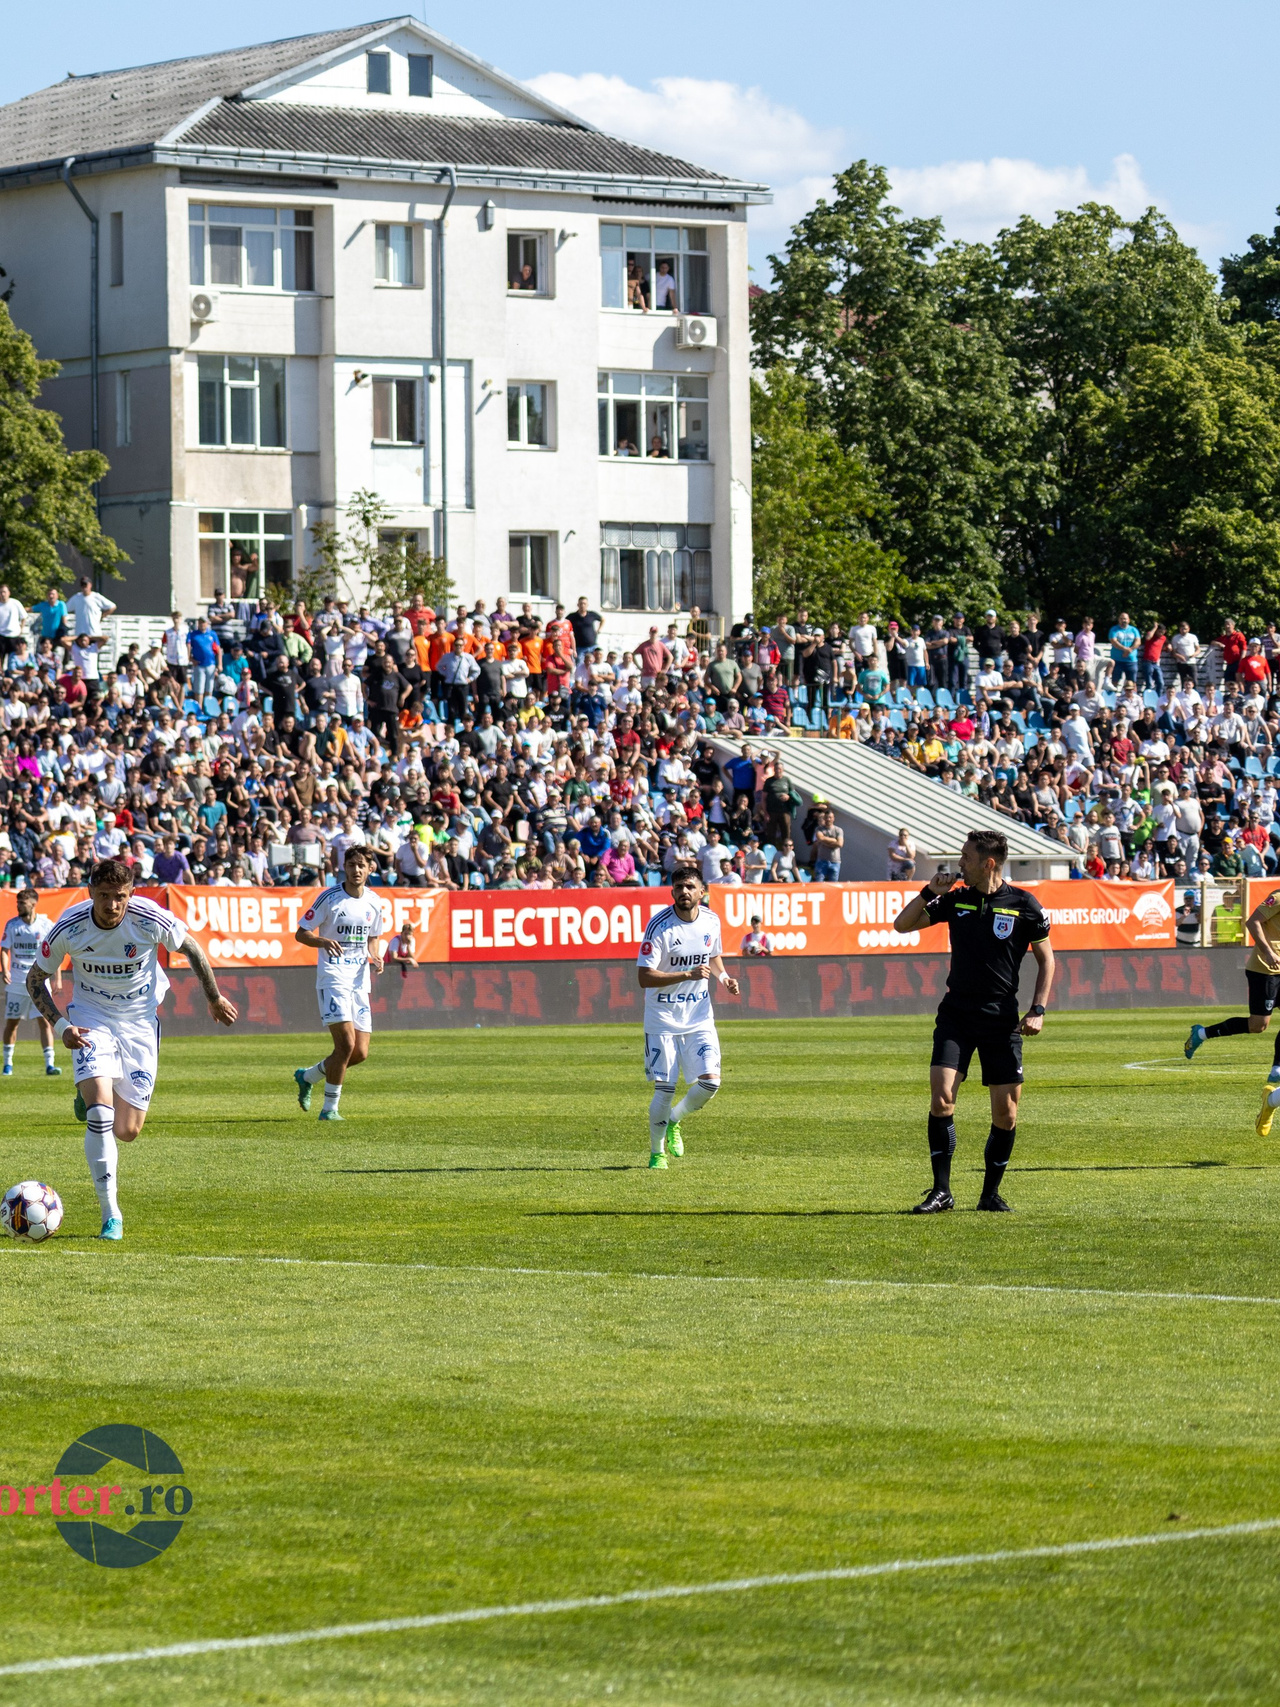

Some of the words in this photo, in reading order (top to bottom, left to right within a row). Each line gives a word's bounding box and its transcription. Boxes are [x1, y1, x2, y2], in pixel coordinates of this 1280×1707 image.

[185, 896, 303, 933] UNIBET
[724, 893, 825, 927] UNIBET
[1090, 907, 1130, 924] GROUP
[82, 960, 145, 974] UNIBET
[80, 982, 151, 1001] ELSACO
[817, 961, 944, 1012] PLAY
[8, 1002, 20, 1013] 93
[329, 998, 338, 1012] 6
[76, 1040, 97, 1064] 32
[651, 1047, 662, 1068] 7
